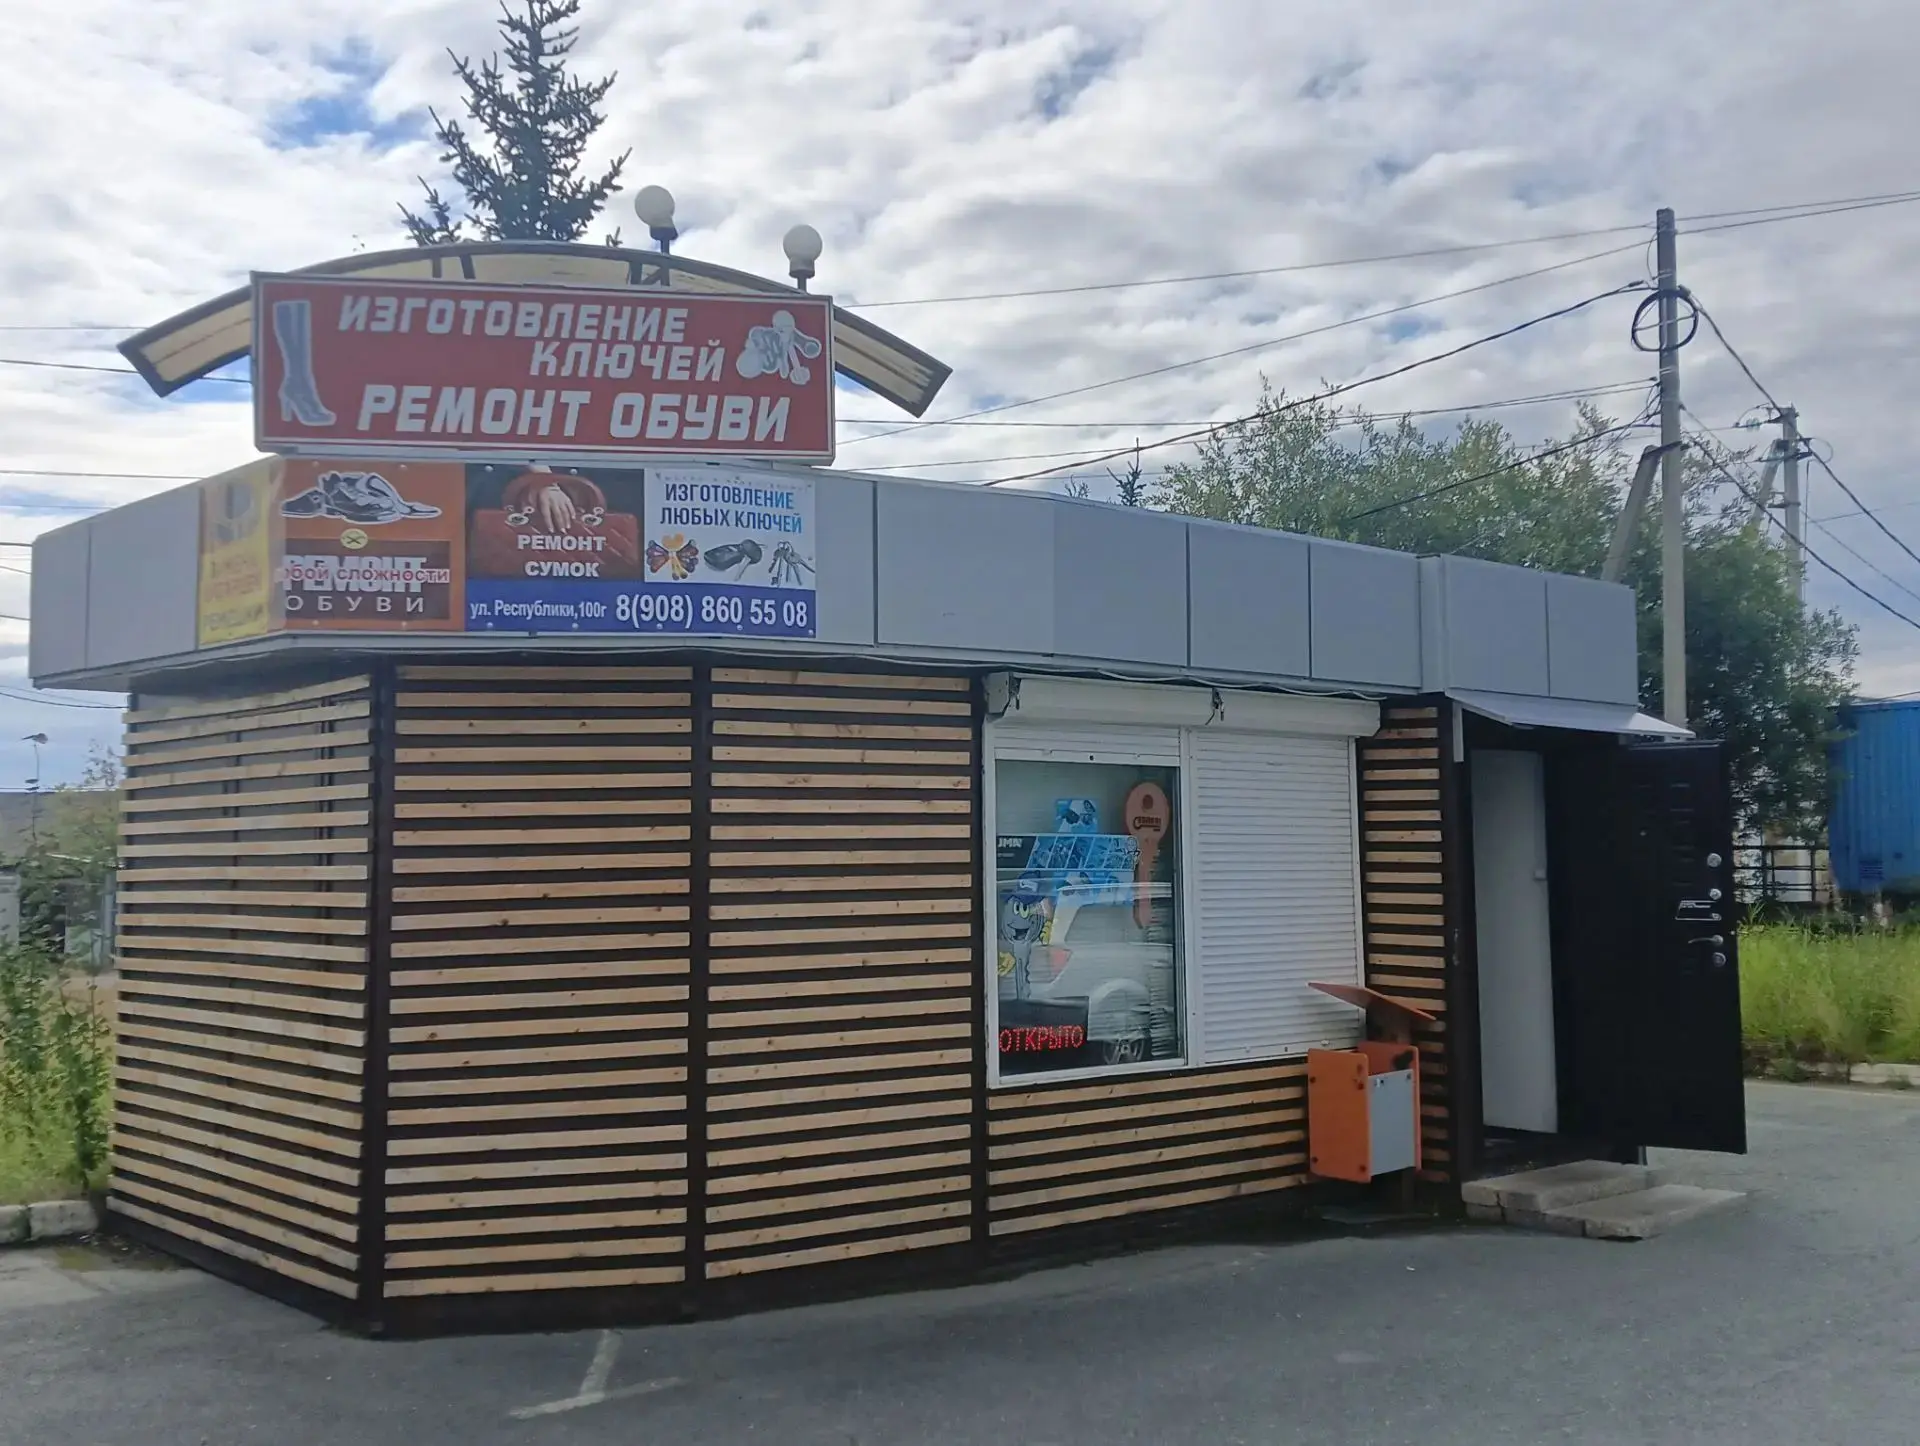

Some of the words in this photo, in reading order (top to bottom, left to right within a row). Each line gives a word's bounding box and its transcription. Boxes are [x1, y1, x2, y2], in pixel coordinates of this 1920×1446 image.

[338, 295, 688, 342] ИЗГОТОВЛЕНИЕ
[530, 339, 726, 381] КЛЮЧЕЙ
[356, 384, 590, 436] РЕМОНТ
[609, 392, 790, 442] ОБУВИ
[665, 483, 794, 509] ИЗГОТОВЛЕНИЕ
[660, 507, 730, 527] ЛЮБЫХ
[735, 512, 802, 534] КЛЮЧЕЙ
[517, 534, 607, 551] РЕМОНТ
[337, 567, 450, 583] сложности
[525, 560, 600, 577] СУМОК
[286, 595, 424, 612] ОБУВИ
[470, 602, 491, 619] ул.
[616, 594, 693, 629] 8(908)
[702, 595, 743, 624] 860
[750, 598, 776, 625] 55
[783, 600, 808, 627] 08
[1000, 1025, 1085, 1053] ОТКРЫТО
